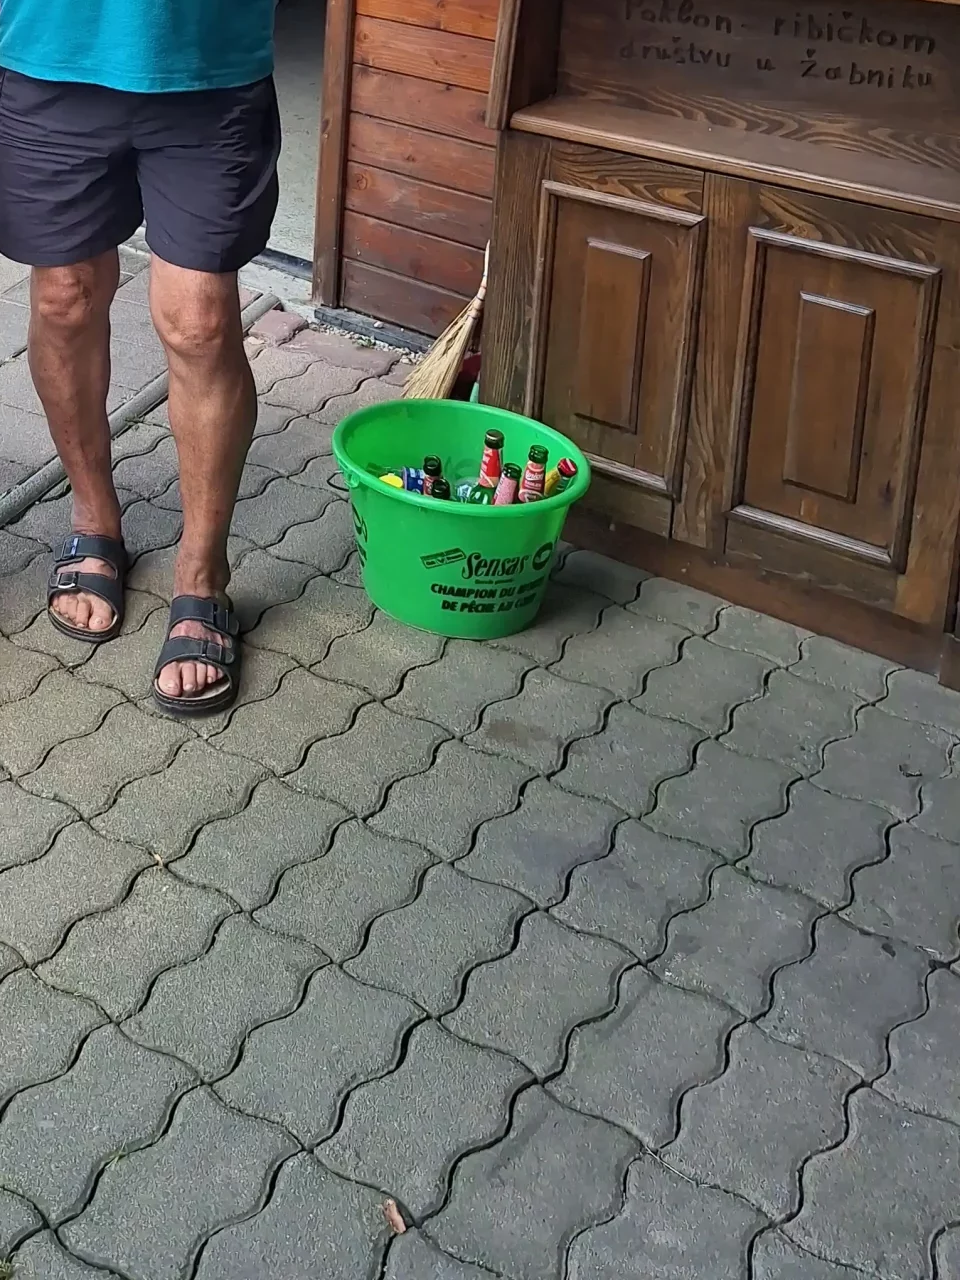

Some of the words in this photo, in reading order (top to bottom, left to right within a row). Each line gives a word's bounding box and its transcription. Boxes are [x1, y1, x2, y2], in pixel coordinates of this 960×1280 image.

[773, 10, 937, 56] ribičkom
[756, 57, 777, 72] u
[430, 583, 497, 599] CHAMPION
[498, 586, 514, 599] DU
[441, 599, 458, 612] DE
[460, 600, 496, 614] PÊCHE
